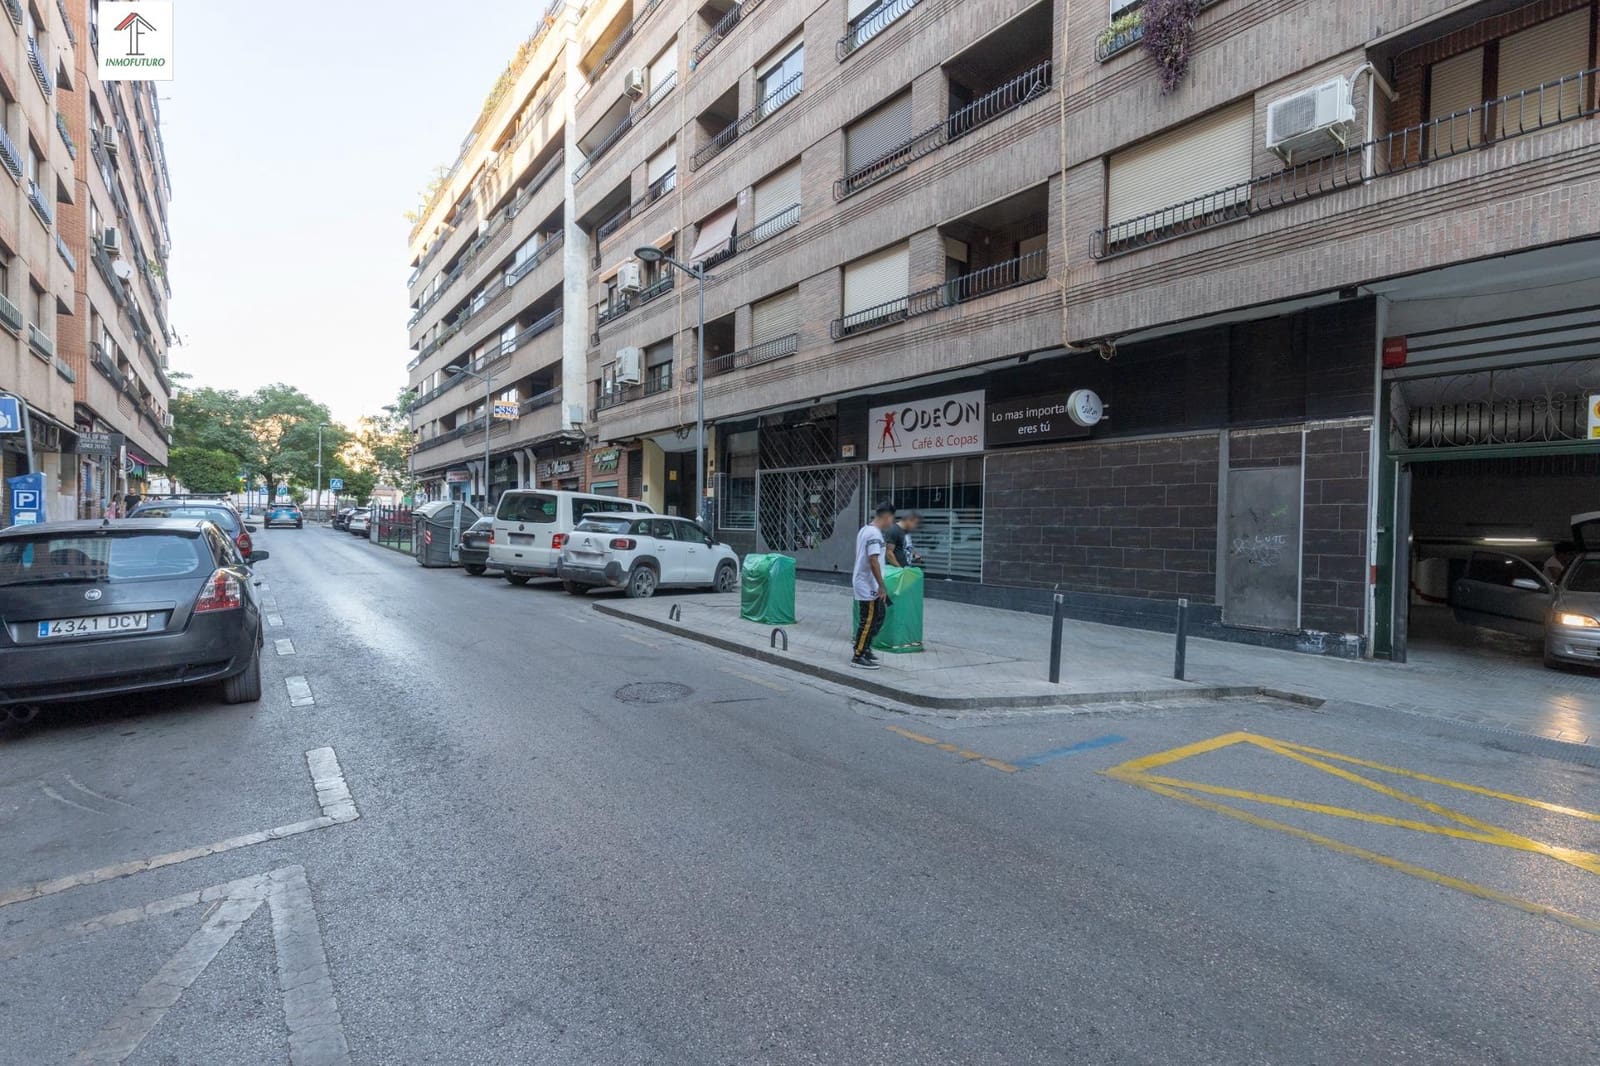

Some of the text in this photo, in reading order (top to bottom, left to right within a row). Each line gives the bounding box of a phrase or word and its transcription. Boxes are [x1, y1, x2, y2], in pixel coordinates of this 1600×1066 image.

[992, 412, 1003, 422] Lo
[1005, 411, 1024, 420] mas
[1018, 421, 1051, 434] eres tú
[912, 434, 978, 450] Café & Copas
[18, 493, 35, 506] P
[52, 615, 143, 634] 4341 DCV
